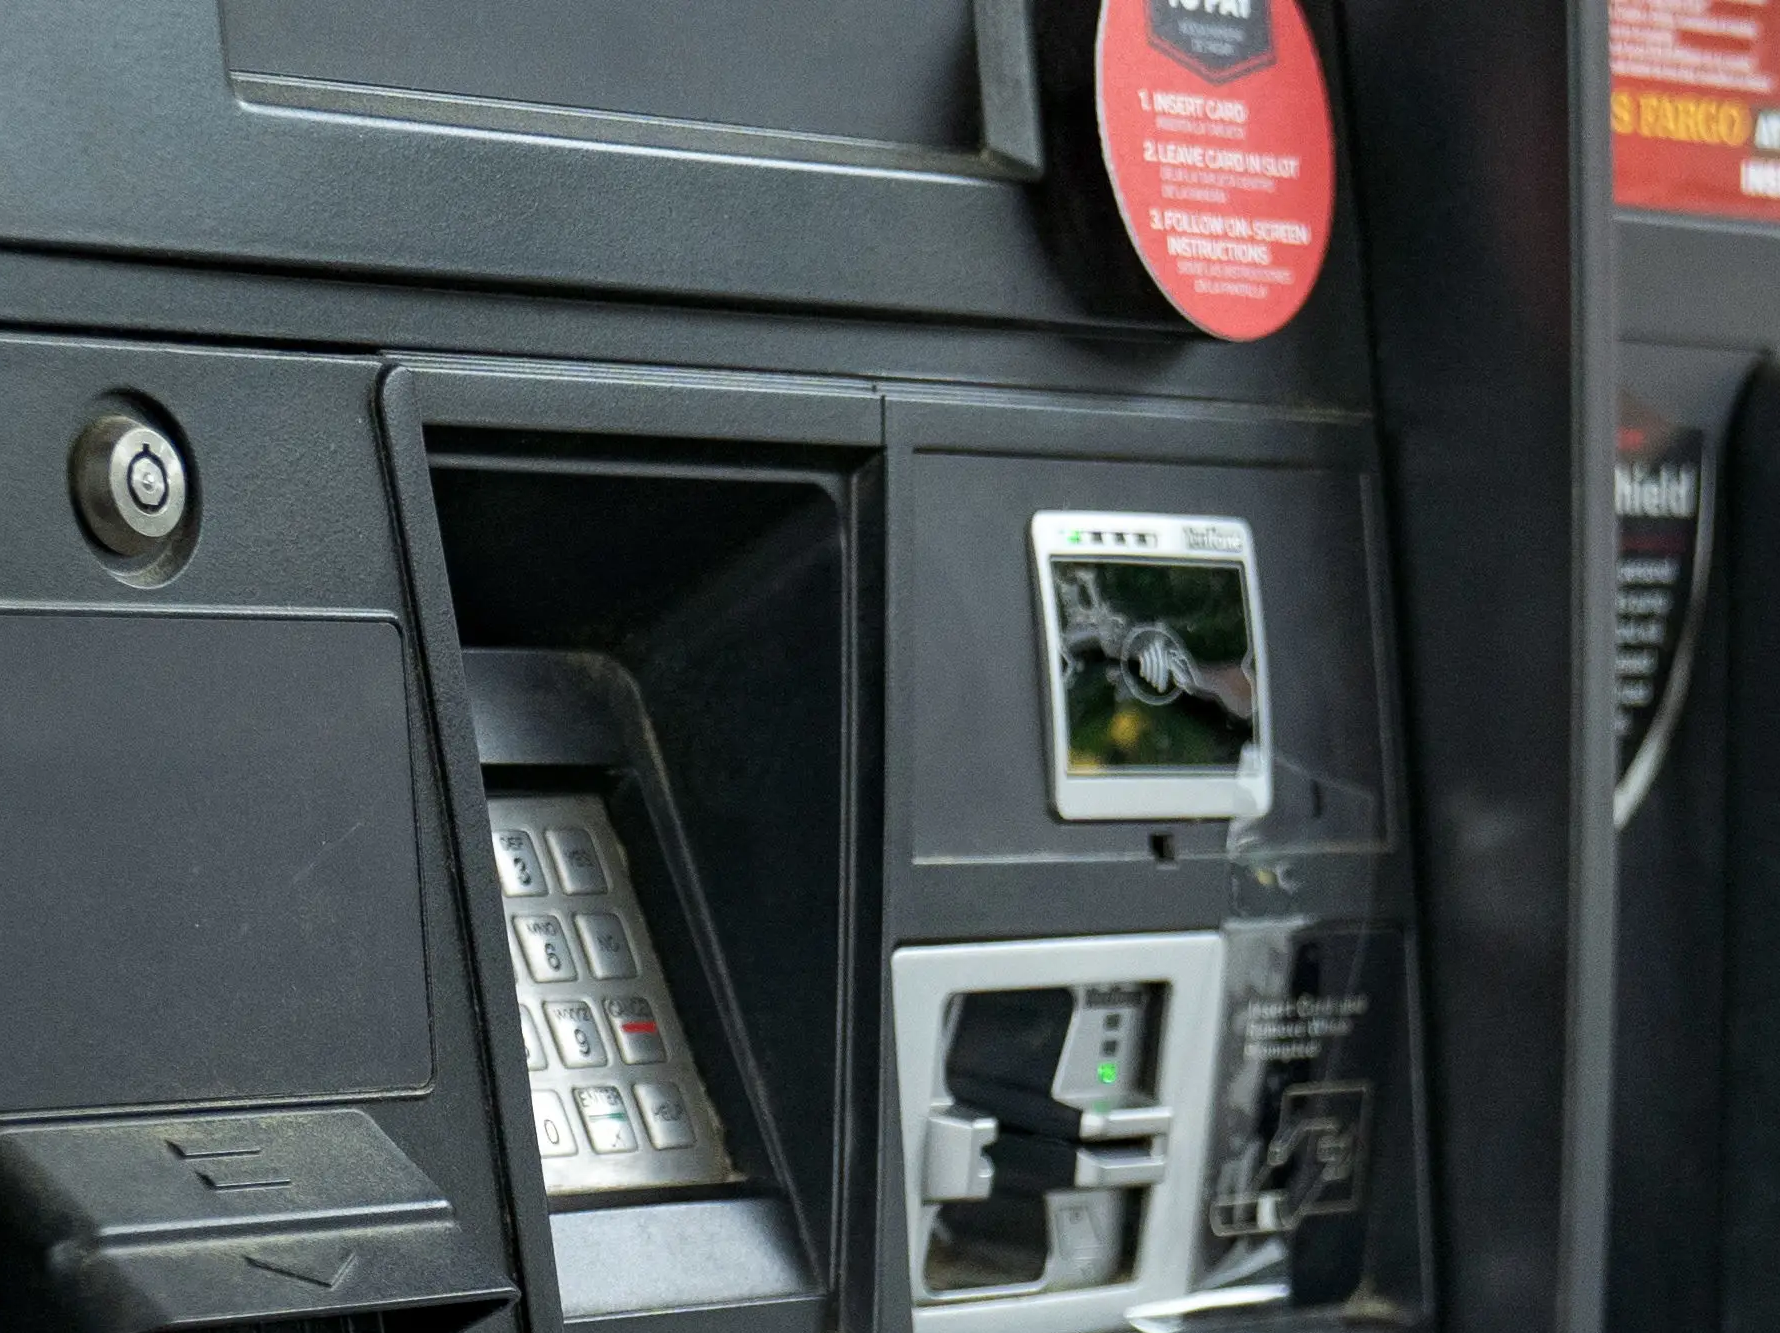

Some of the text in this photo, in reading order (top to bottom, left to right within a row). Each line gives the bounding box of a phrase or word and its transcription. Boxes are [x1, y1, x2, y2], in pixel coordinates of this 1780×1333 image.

[1153, 92, 1204, 118] INSERT
[1205, 100, 1247, 123] CARD
[1639, 93, 1750, 146] FARGO
[1158, 142, 1204, 167] LEAVE
[1205, 149, 1244, 172] CARD
[1246, 153, 1261, 174] IN
[1262, 156, 1299, 178] SLOT
[1164, 210, 1224, 237] FOLLOW
[1167, 235, 1270, 264] INSTRUCTIONS
[544, 943, 561, 972] 6
[574, 1028, 591, 1057] 9
